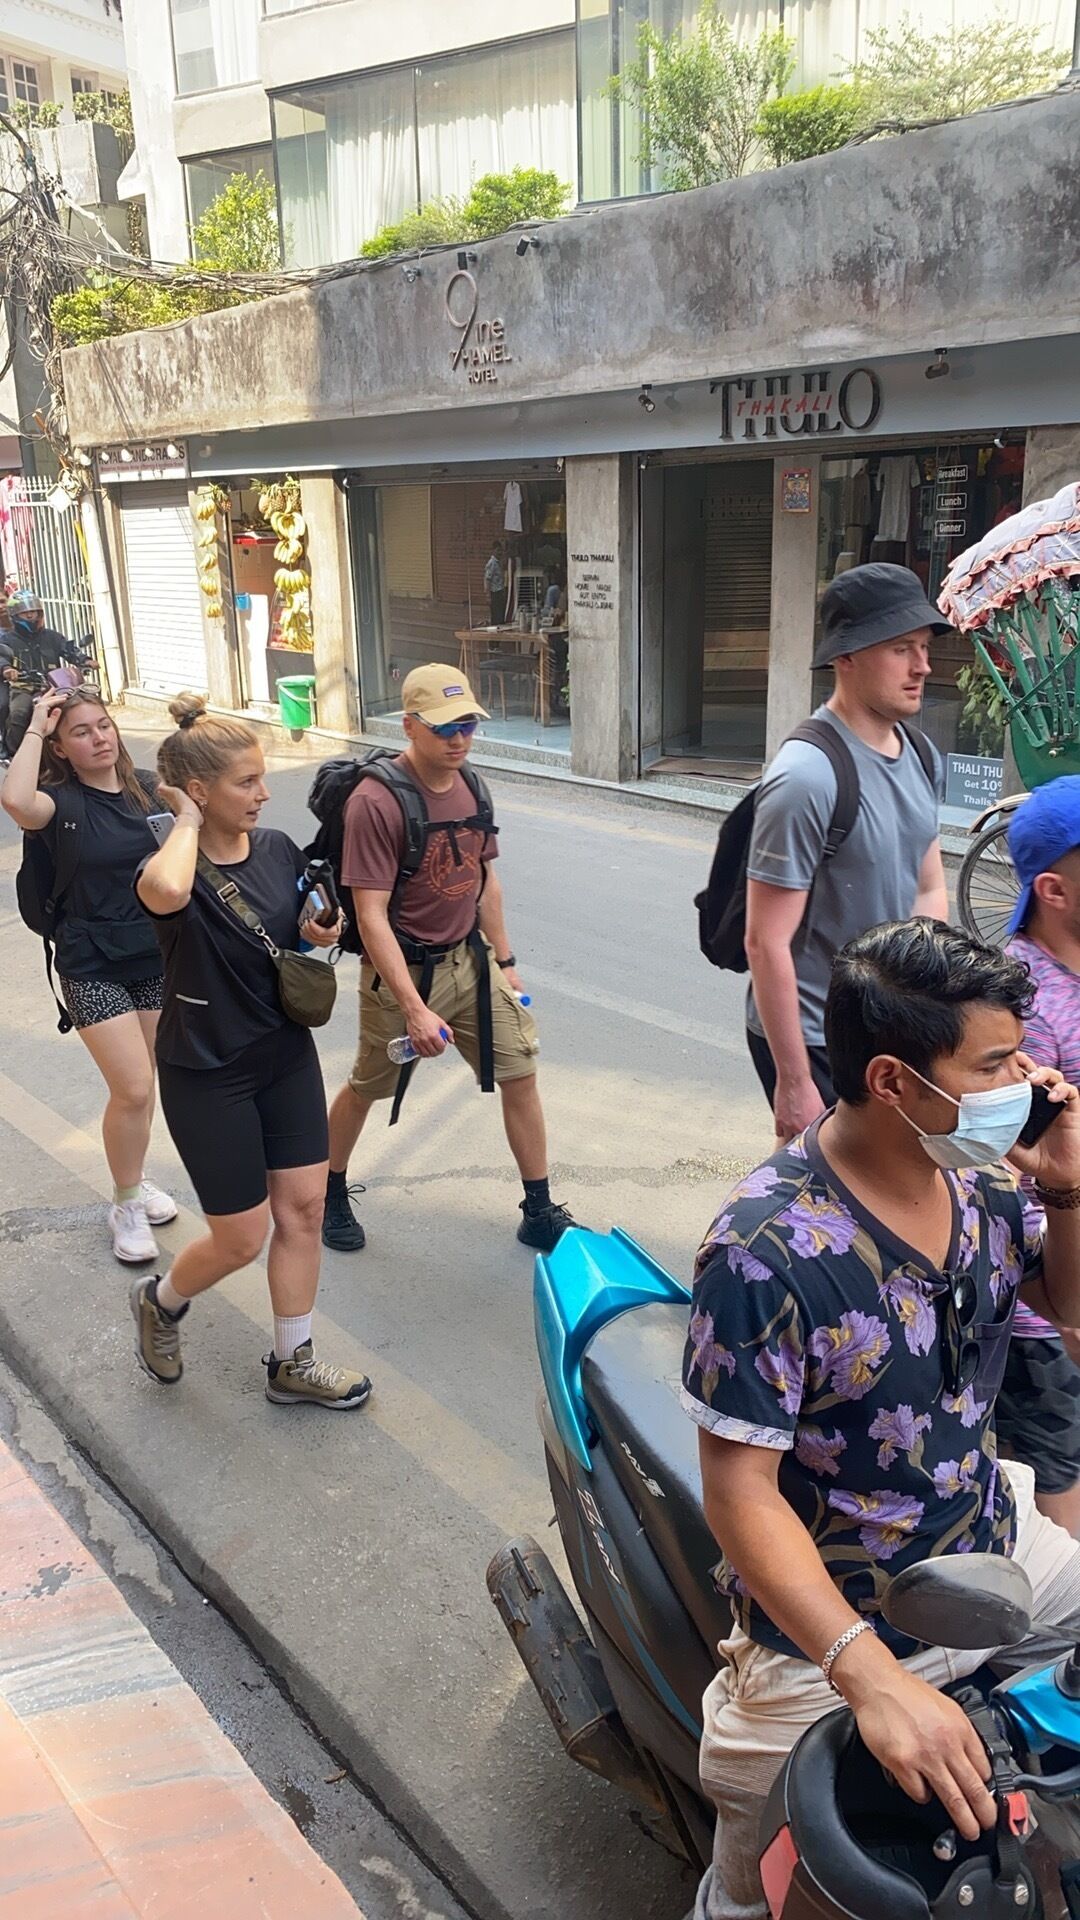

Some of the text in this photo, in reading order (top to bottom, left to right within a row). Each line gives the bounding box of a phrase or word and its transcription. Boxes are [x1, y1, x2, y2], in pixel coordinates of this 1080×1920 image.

[709, 367, 881, 439] THULO
[736, 395, 833, 417] THAKALI
[938, 467, 966, 479] Breakfast
[940, 495, 962, 507] Lunch
[939, 522, 962, 533] Dinner
[952, 761, 981, 776] THALI
[964, 780, 980, 790] Get
